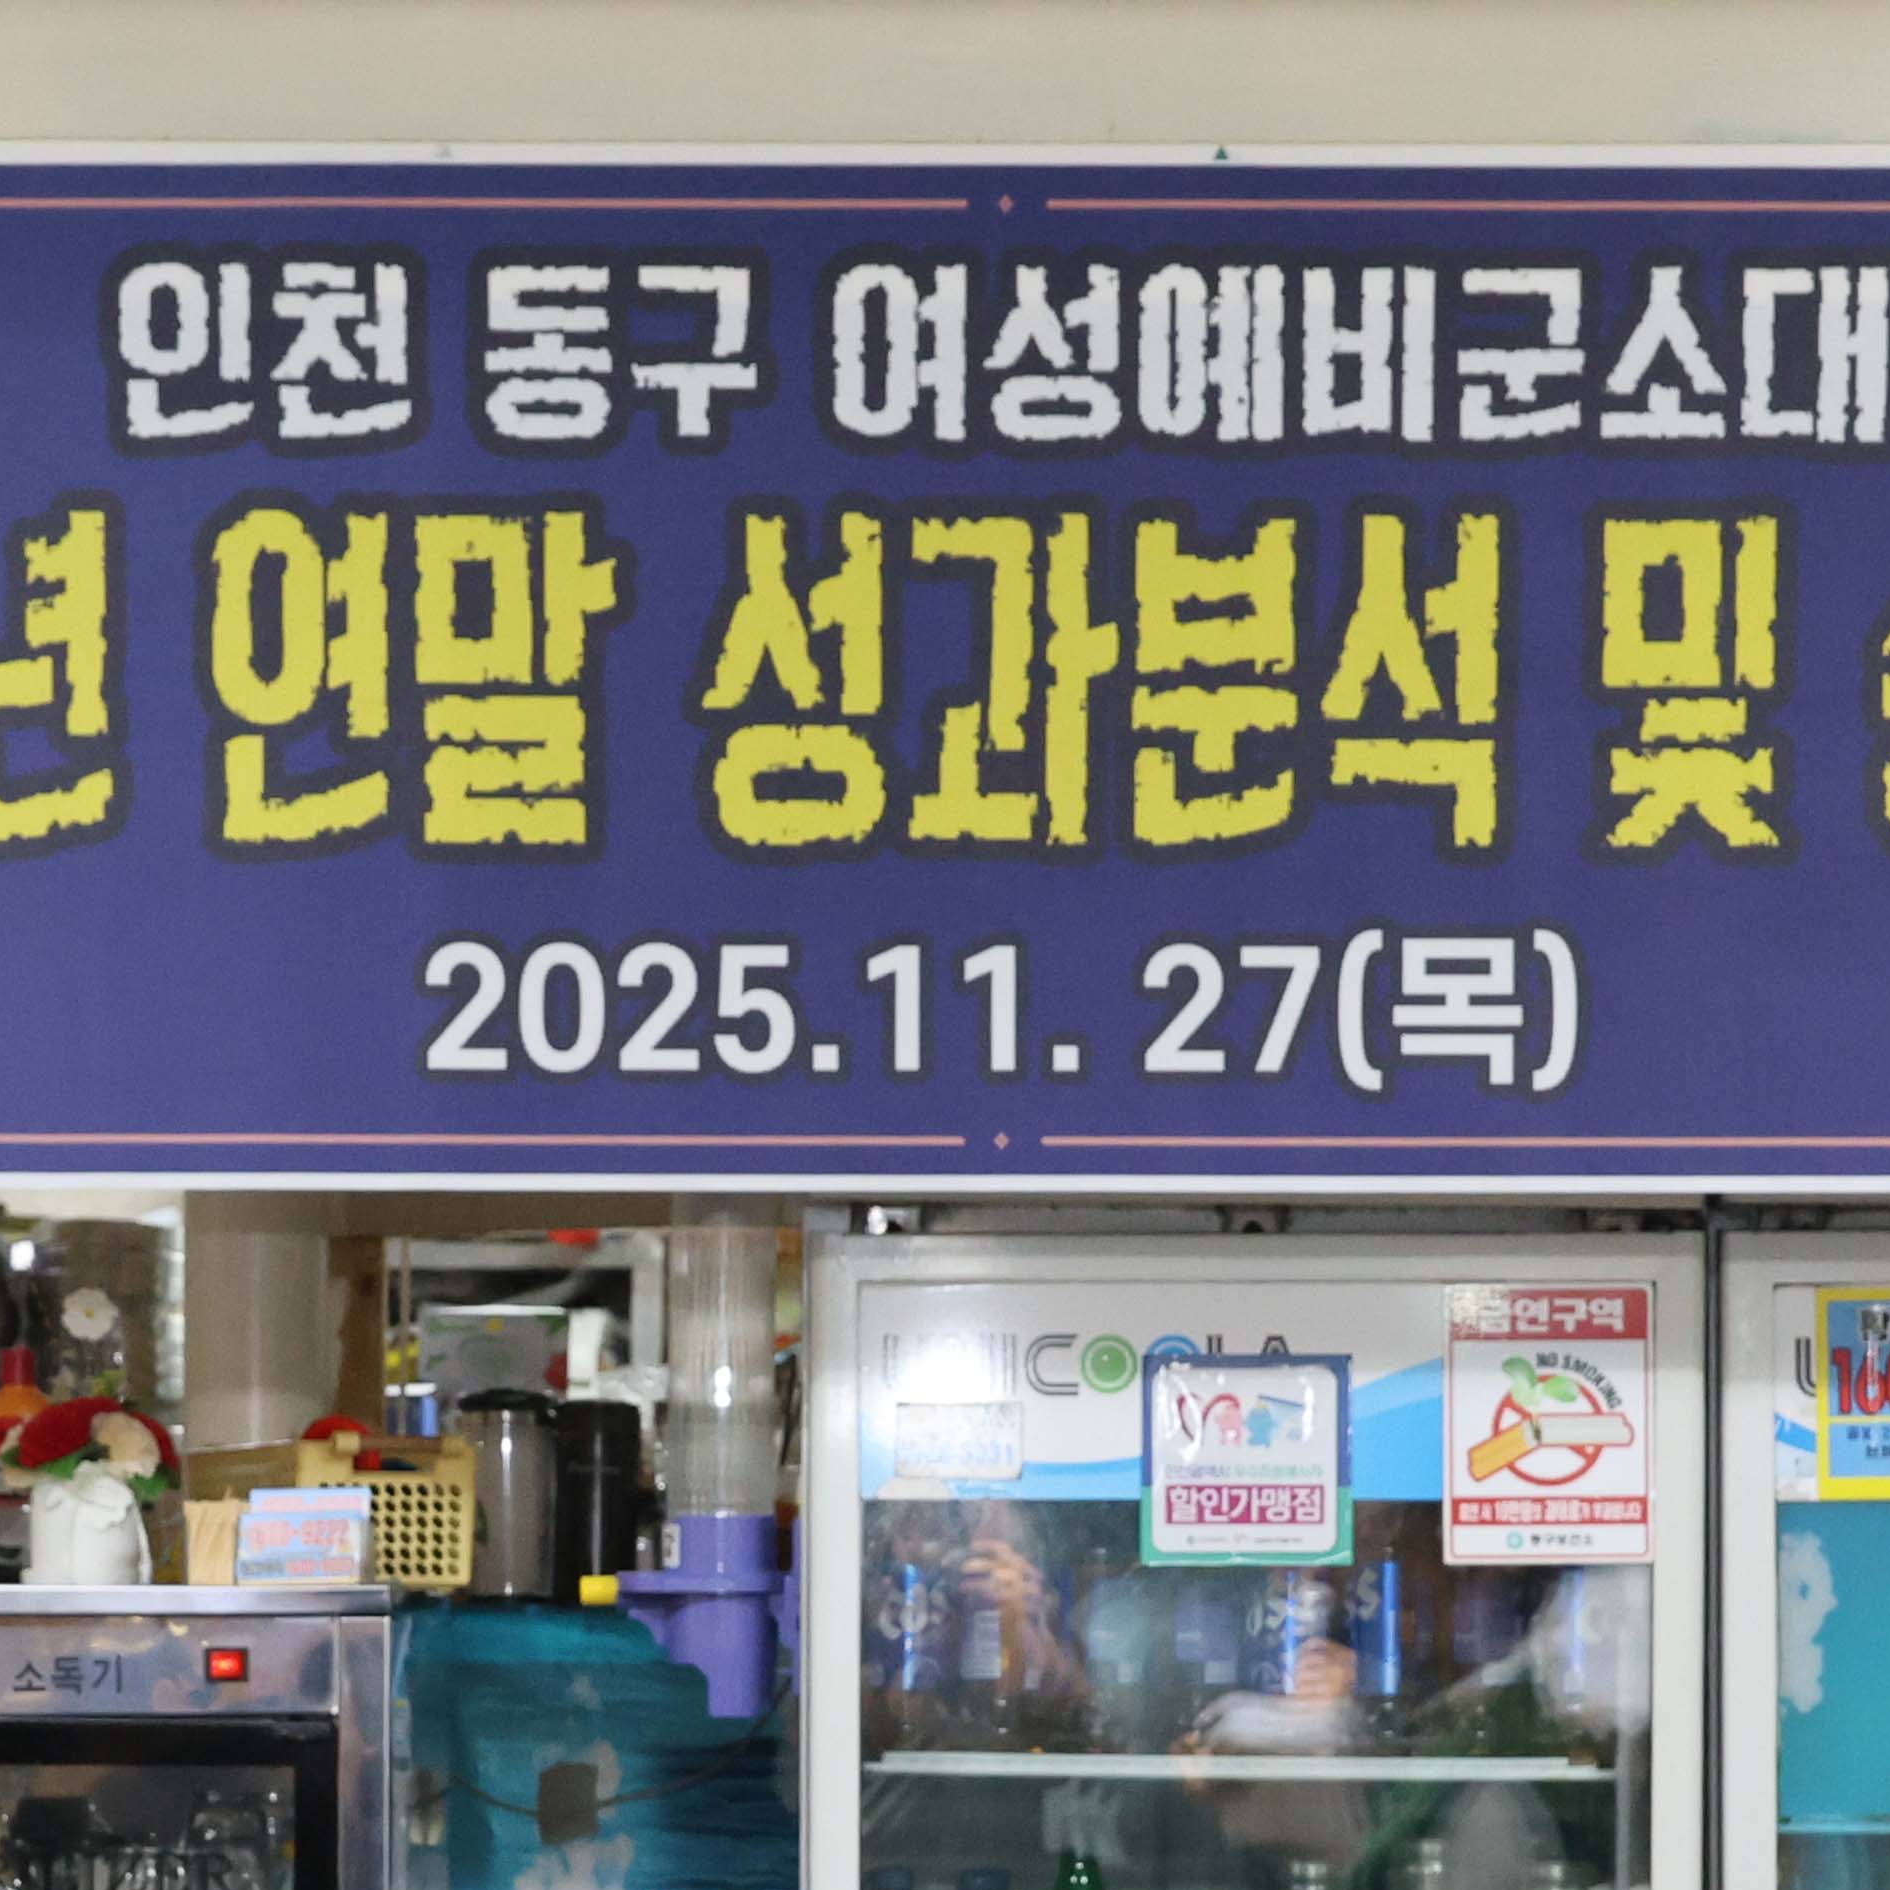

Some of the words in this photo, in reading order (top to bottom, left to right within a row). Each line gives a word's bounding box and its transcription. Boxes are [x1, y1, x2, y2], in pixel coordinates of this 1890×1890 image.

[118, 261, 412, 439] 인천
[484, 265, 758, 440] 동구
[832, 263, 1890, 444] 여성예비군소대
[211, 508, 617, 845] 연말
[701, 511, 1500, 848] 성과분석
[1601, 515, 1780, 848] 및
[1142, 928, 1578, 1092] 27(목)
[1536, 1351, 1559, 1369] NO
[1168, 1485, 1324, 1524] 할인가맹점
[10, 1653, 125, 1696] 소독기
